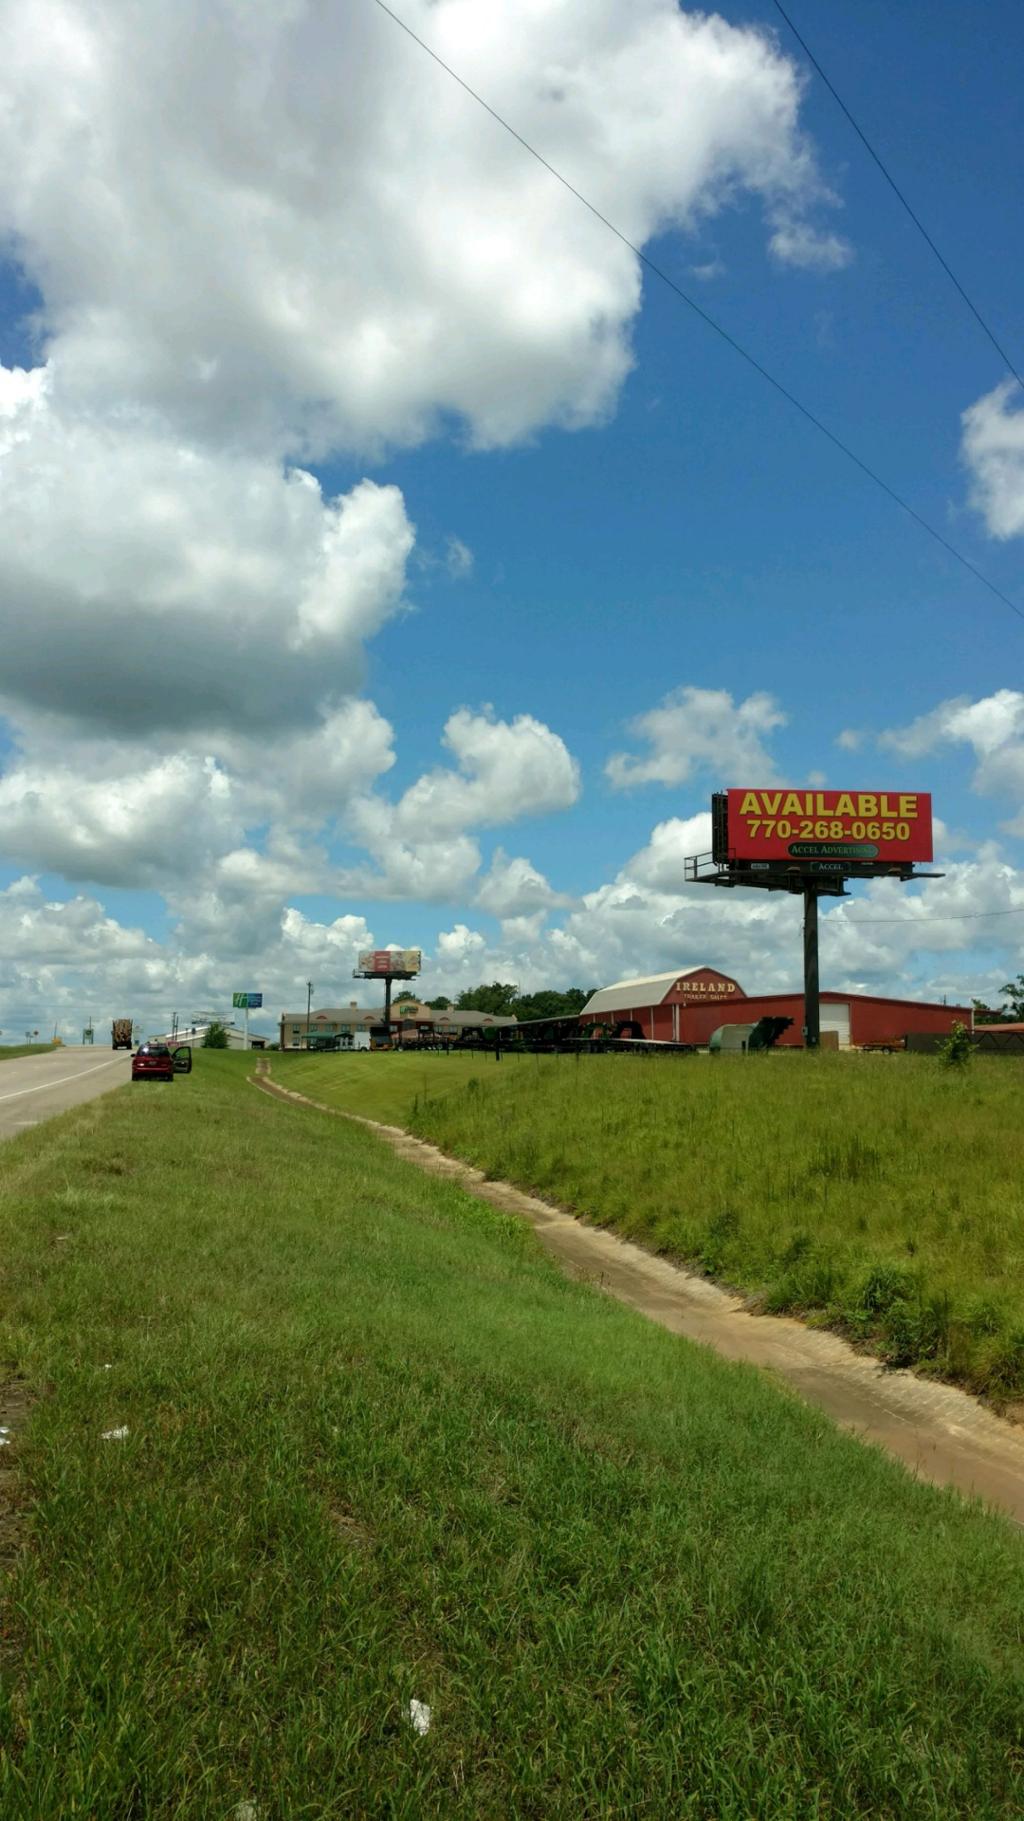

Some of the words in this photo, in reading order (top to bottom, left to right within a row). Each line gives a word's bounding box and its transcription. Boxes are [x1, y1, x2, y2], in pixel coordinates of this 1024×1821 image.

[739, 792, 918, 818] AVAILABLE
[746, 819, 910, 841] 770-268-0650
[791, 845, 820, 854] ACCEL
[821, 845, 872, 855] ADVERTI
[676, 982, 735, 992] IRELAND
